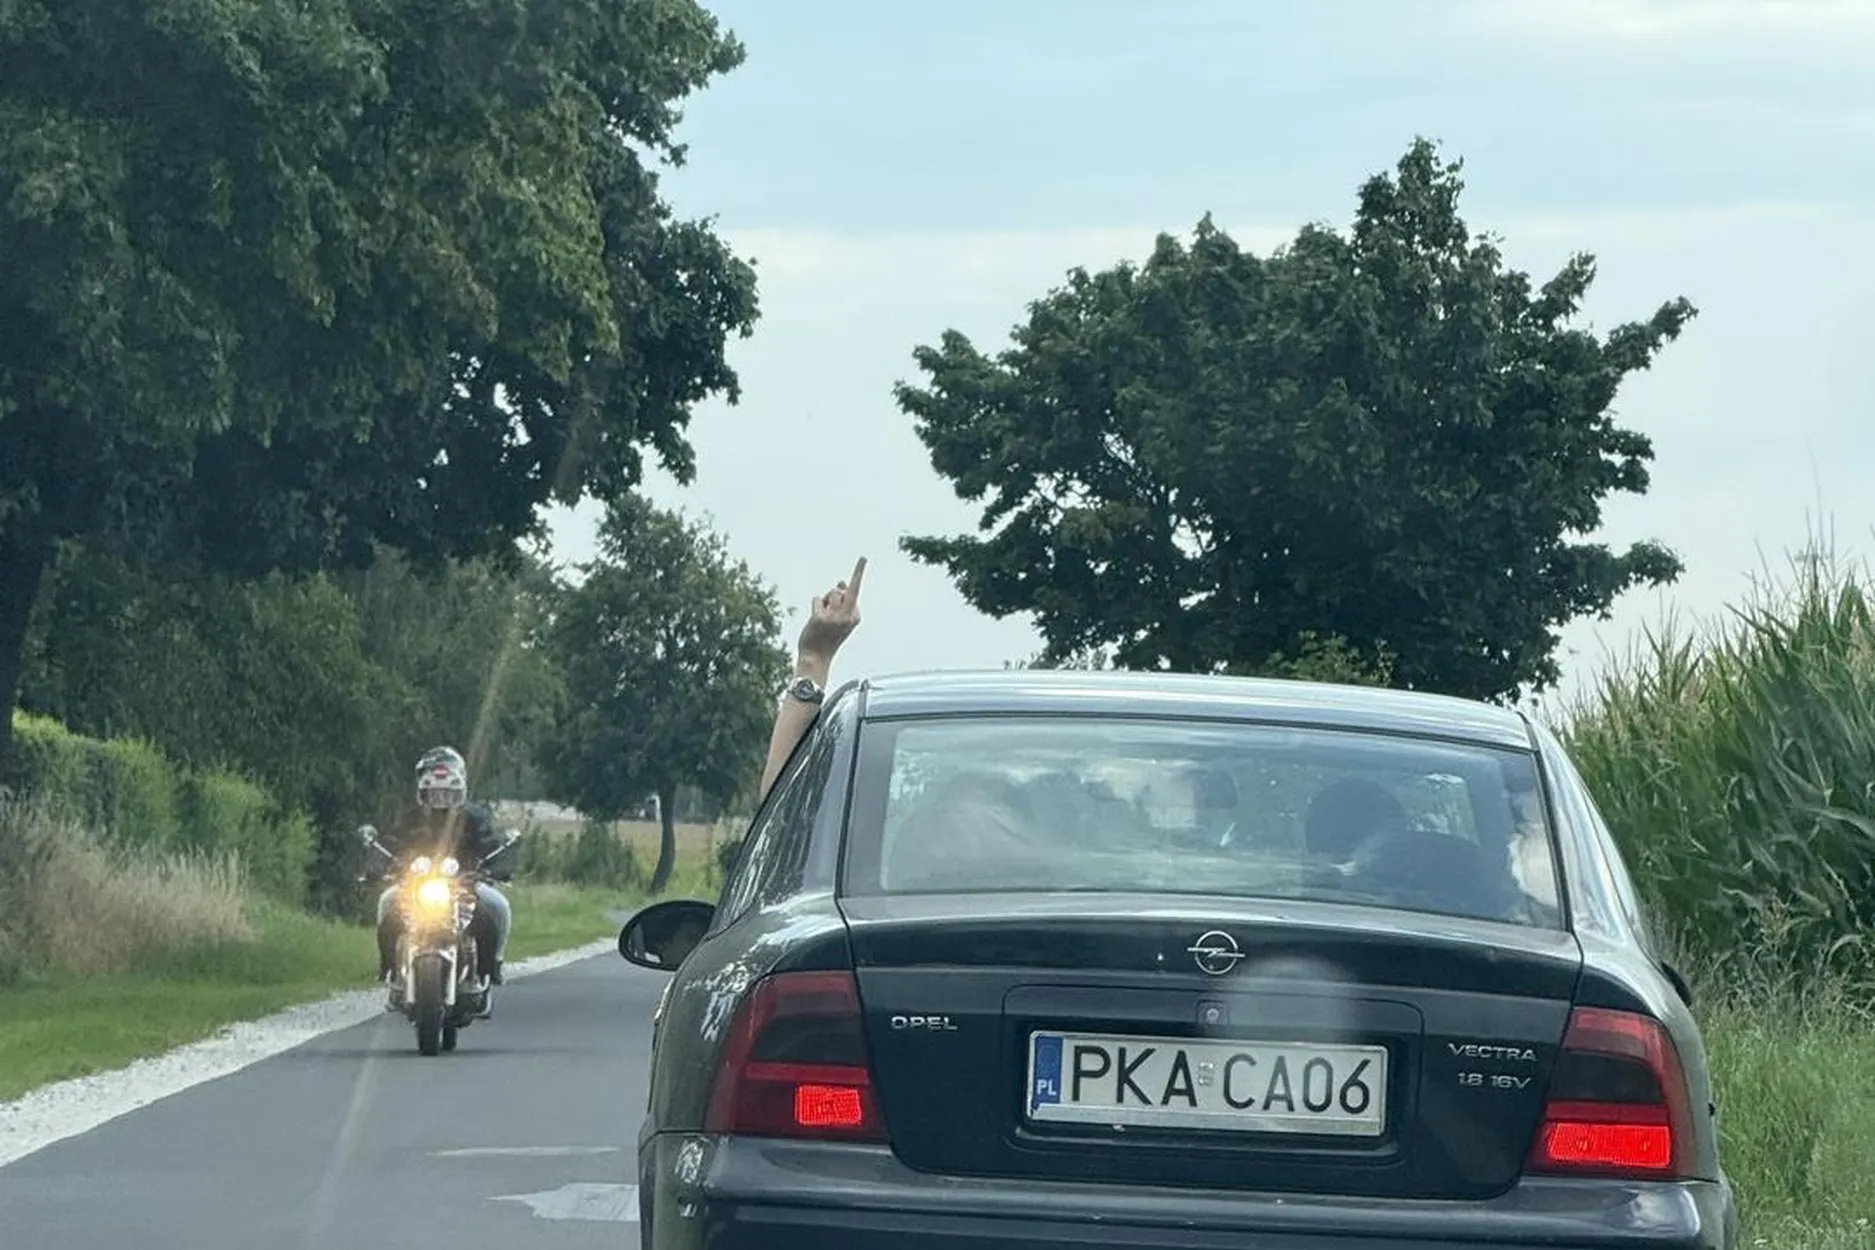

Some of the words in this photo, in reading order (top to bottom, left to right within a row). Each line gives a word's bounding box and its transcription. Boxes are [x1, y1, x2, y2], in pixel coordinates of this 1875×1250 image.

[891, 1016, 958, 1031] OPEL
[1447, 1043, 1537, 1061] VECTRA
[1036, 1079, 1058, 1097] PL
[1071, 1045, 1198, 1108] PKA
[1223, 1053, 1372, 1114] CA06
[1491, 1075, 1532, 1089] 16V
